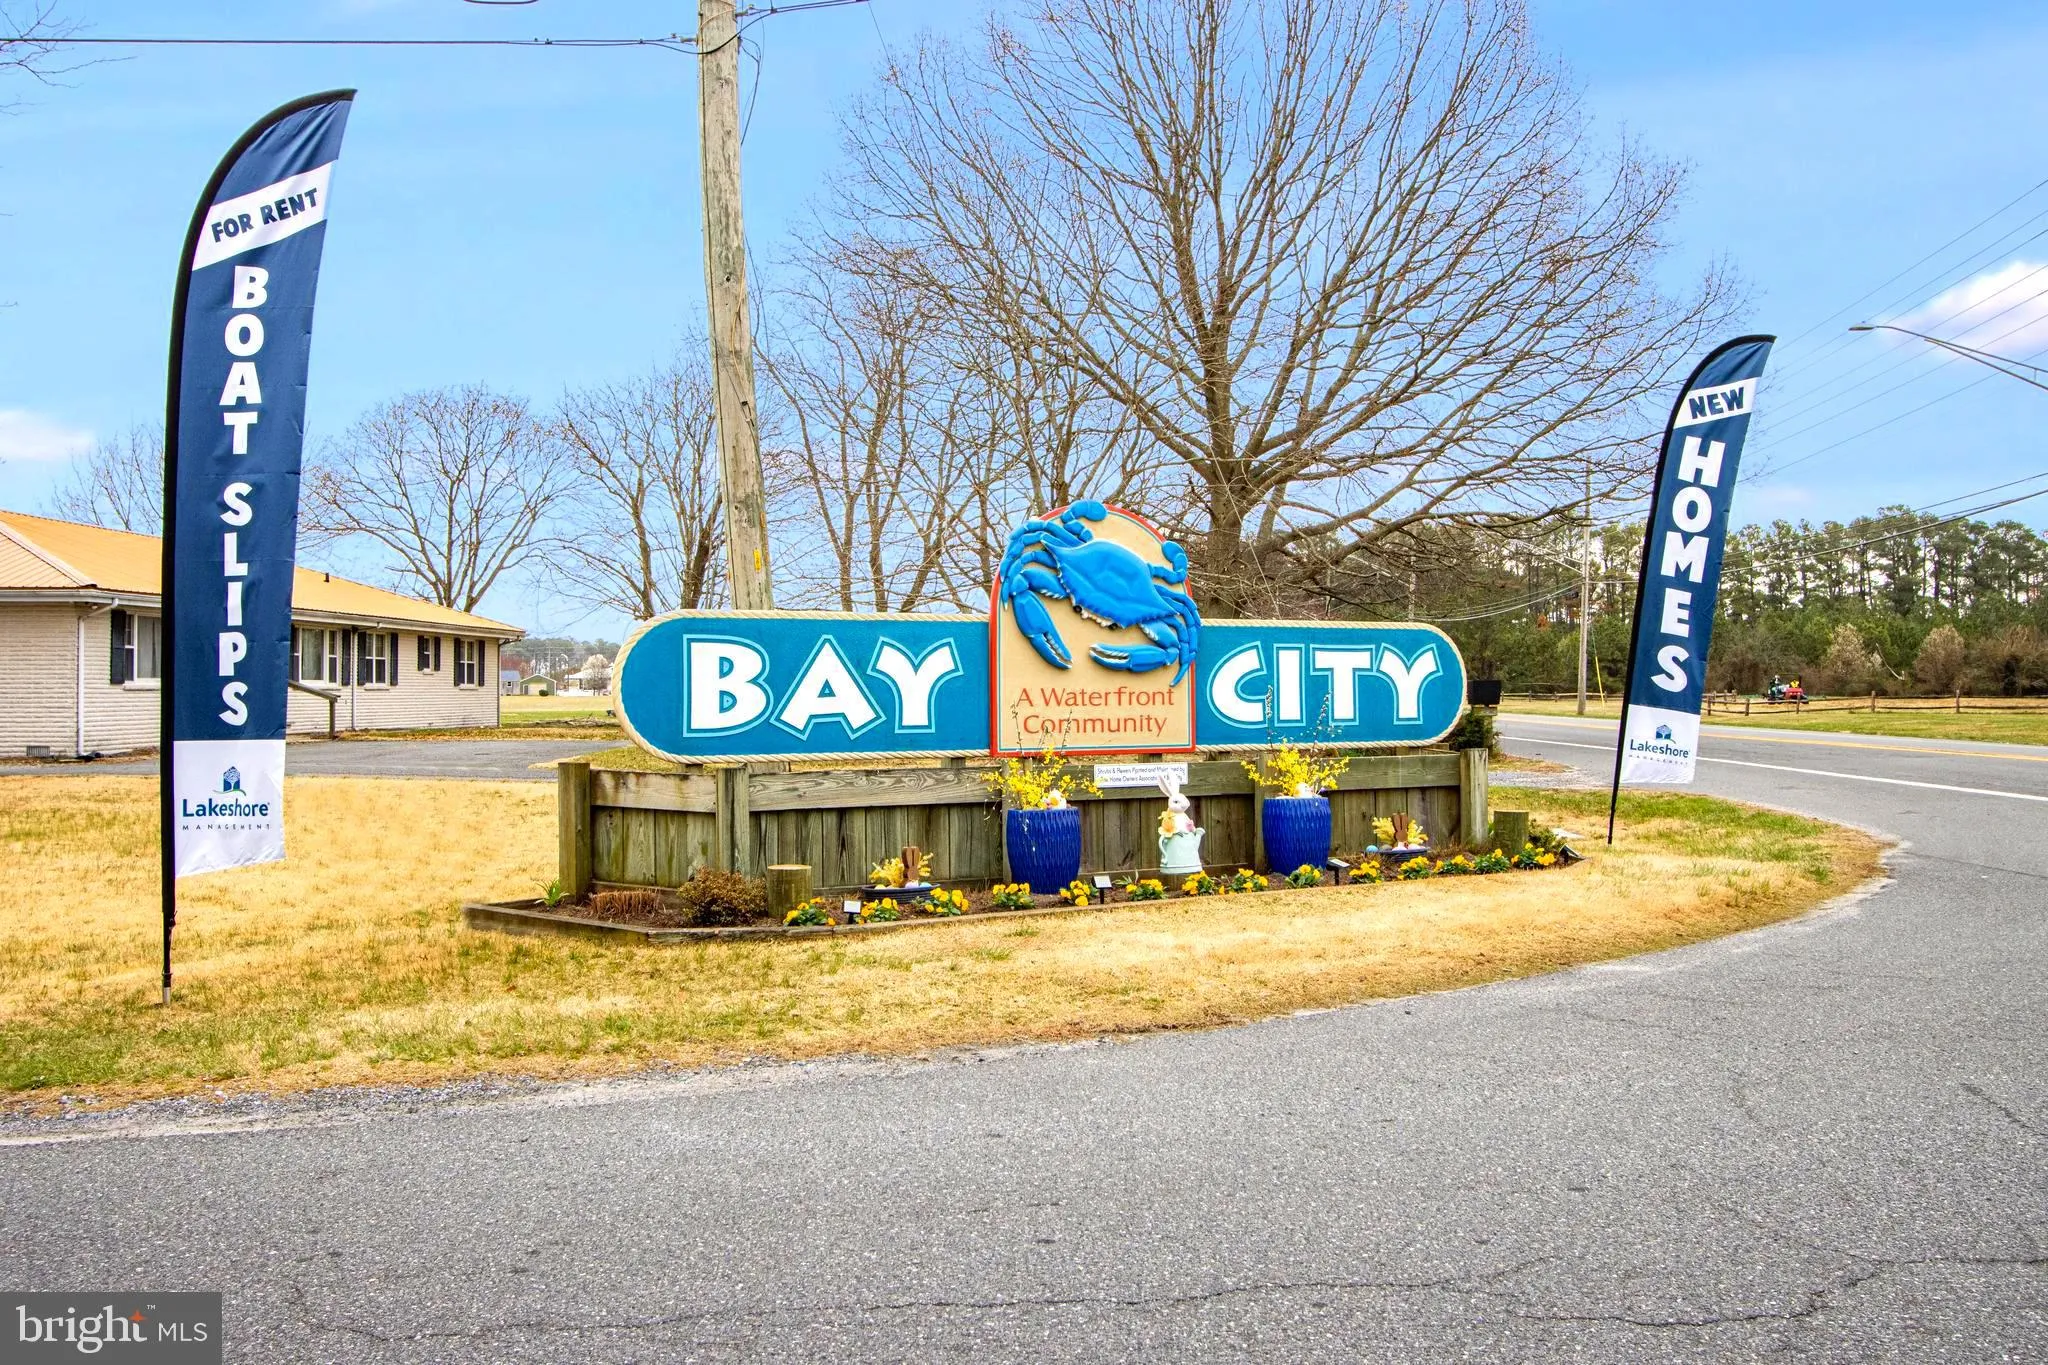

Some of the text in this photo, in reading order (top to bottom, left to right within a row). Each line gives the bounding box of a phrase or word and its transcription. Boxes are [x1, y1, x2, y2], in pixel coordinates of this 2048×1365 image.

[211, 187, 318, 243] FOR RENT
[1689, 386, 1744, 420] NEW
[218, 265, 269, 727] BOAT SLIPS
[1650, 436, 1726, 693] HOMES
[683, 634, 1444, 741] BAY CITY
[1017, 686, 1175, 707] A Waterfront
[1023, 714, 1168, 736] Community
[1630, 738, 1689, 758] Lakeshore
[182, 798, 269, 817] Lakeshore
